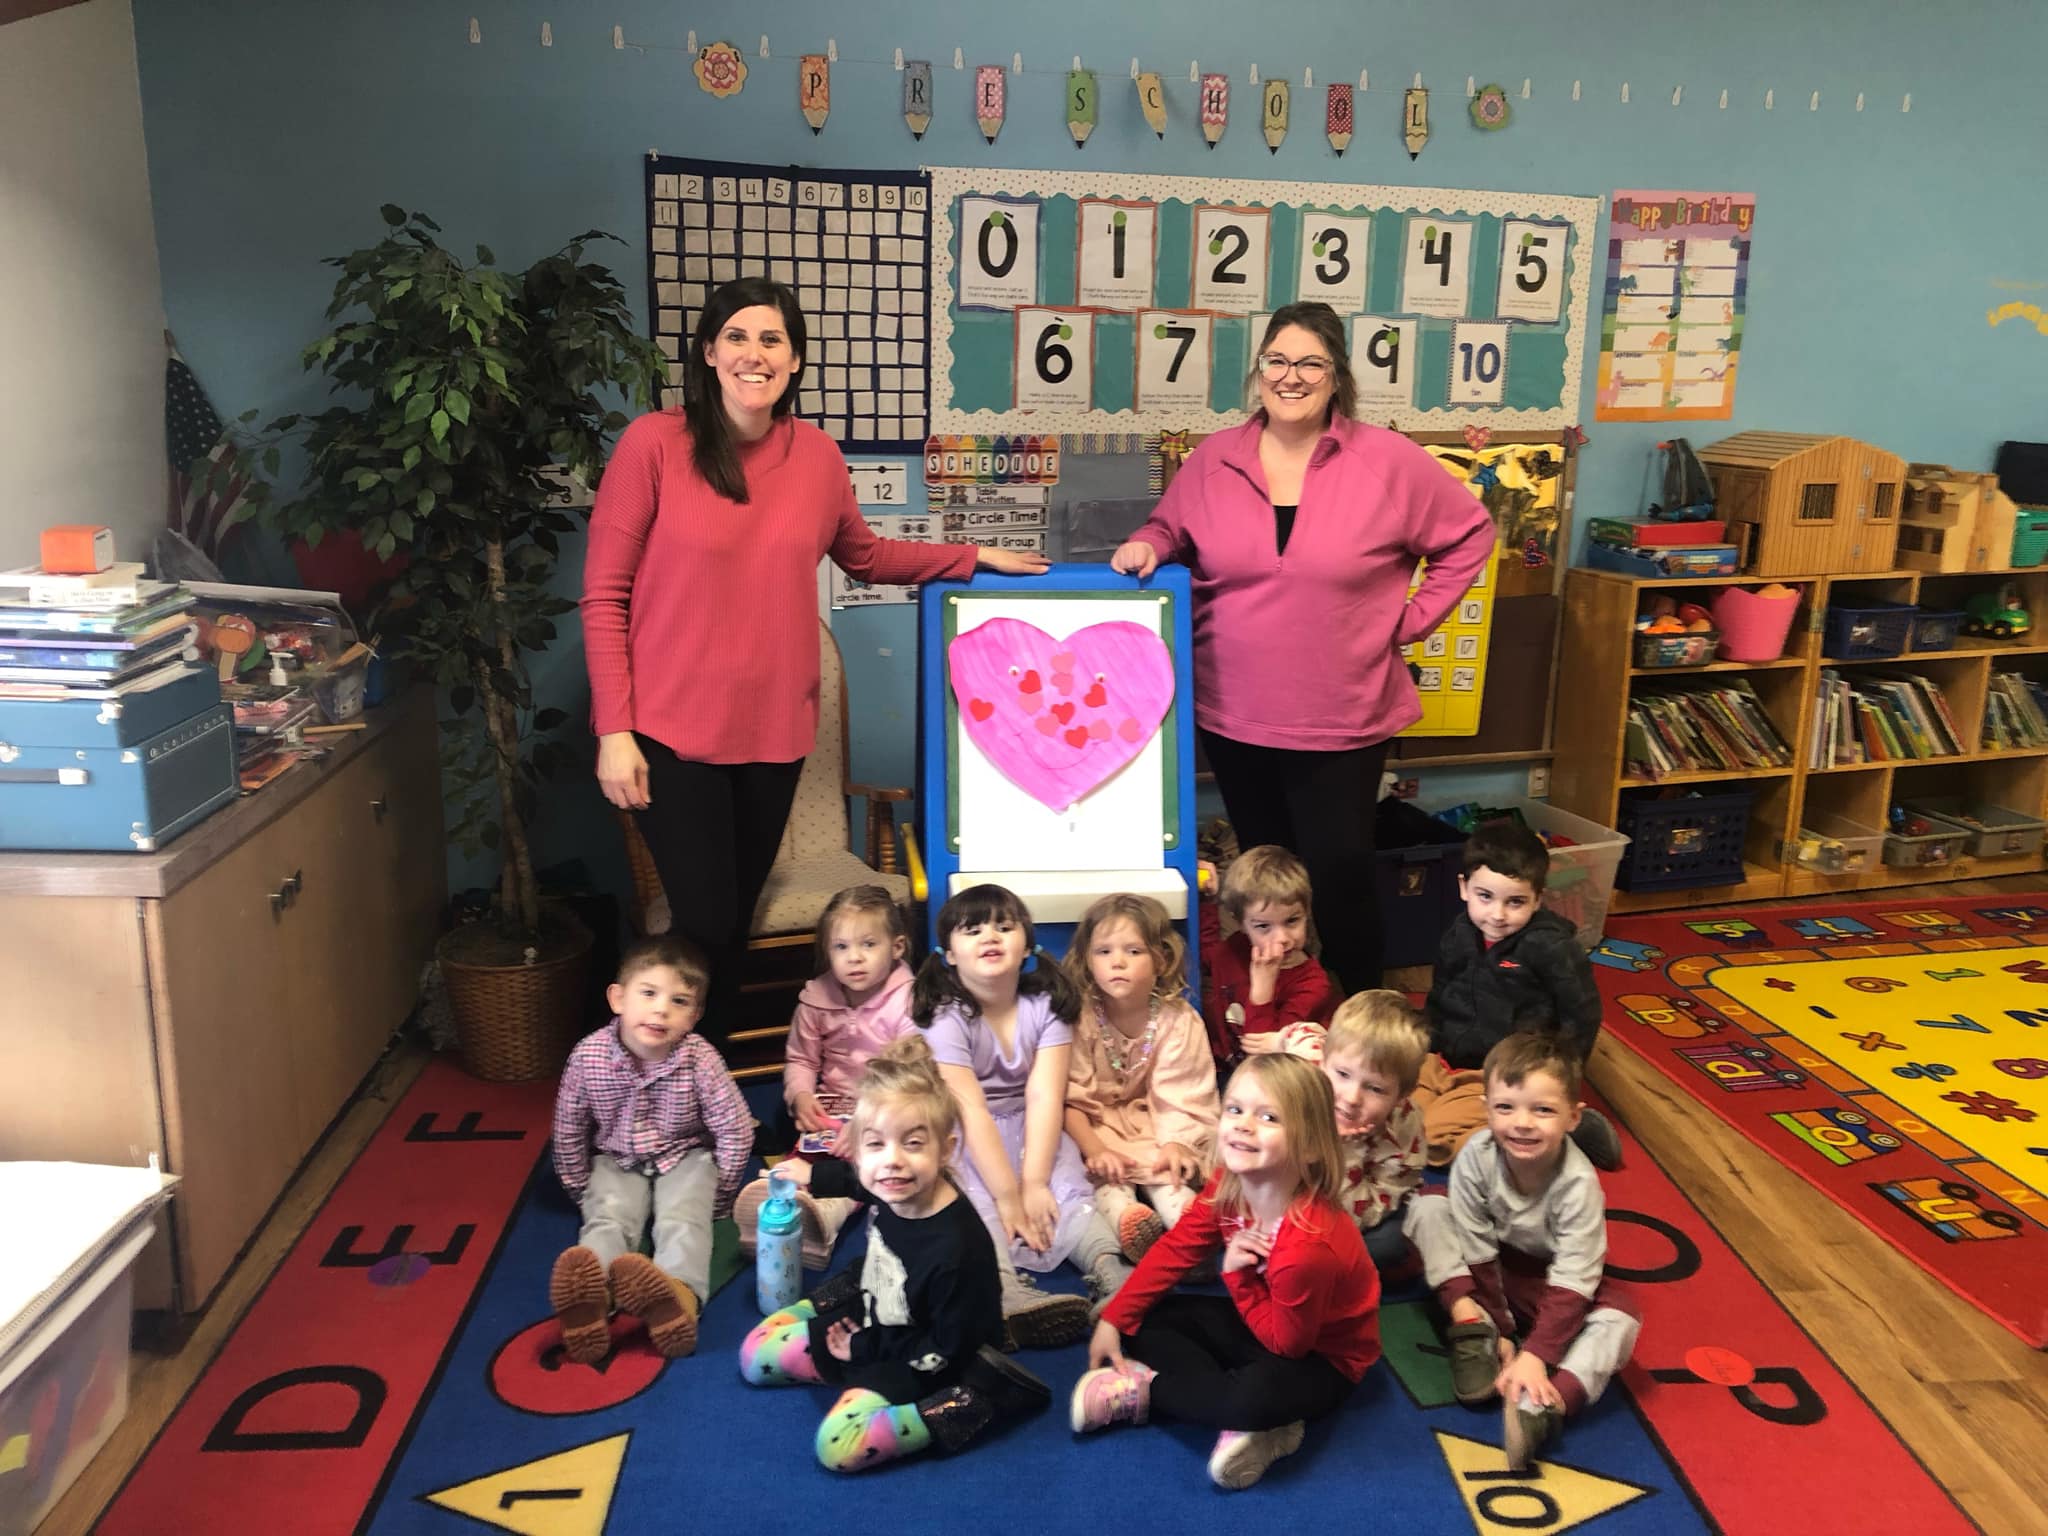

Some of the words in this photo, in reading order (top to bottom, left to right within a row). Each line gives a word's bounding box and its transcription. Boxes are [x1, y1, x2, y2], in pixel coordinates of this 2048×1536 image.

[687, 179, 697, 195] 2
[720, 181, 731, 197] 3
[746, 181, 757, 197] 4
[774, 183, 784, 198] 5
[805, 186, 815, 201] 6
[828, 187, 838, 202] 7
[858, 188, 868, 203] 8
[885, 190, 895, 204] 9
[909, 191, 923, 206] 10
[978, 212, 1018, 278] 0
[1113, 211, 1126, 278] 1
[1210, 224, 1250, 284] 2
[1313, 228, 1350, 285] 3
[1424, 226, 1452, 287] 4
[1515, 232, 1548, 293] 5
[1035, 323, 1073, 384] 6
[1156, 324, 1197, 383] 7
[1366, 326, 1399, 383] 9
[1459, 342, 1500, 383] 10
[929, 455, 1055, 472] SCHEDULE
[873, 482, 893, 500] 12
[975, 488, 998, 496] Table
[975, 496, 1017, 505] Activities
[968, 512, 1006, 525] Circle
[1010, 511, 1039, 523] Time
[969, 536, 999, 547] Small
[1002, 535, 1036, 548] Group
[836, 594, 860, 602] circle
[1814, 919, 1848, 934] t
[403, 1111, 528, 1143] F
[319, 1223, 477, 1268] E
[199, 1364, 388, 1452] D
[1649, 1366, 1828, 1426] P
[499, 1487, 584, 1511] 1
[1463, 1462, 1562, 1529] 10
